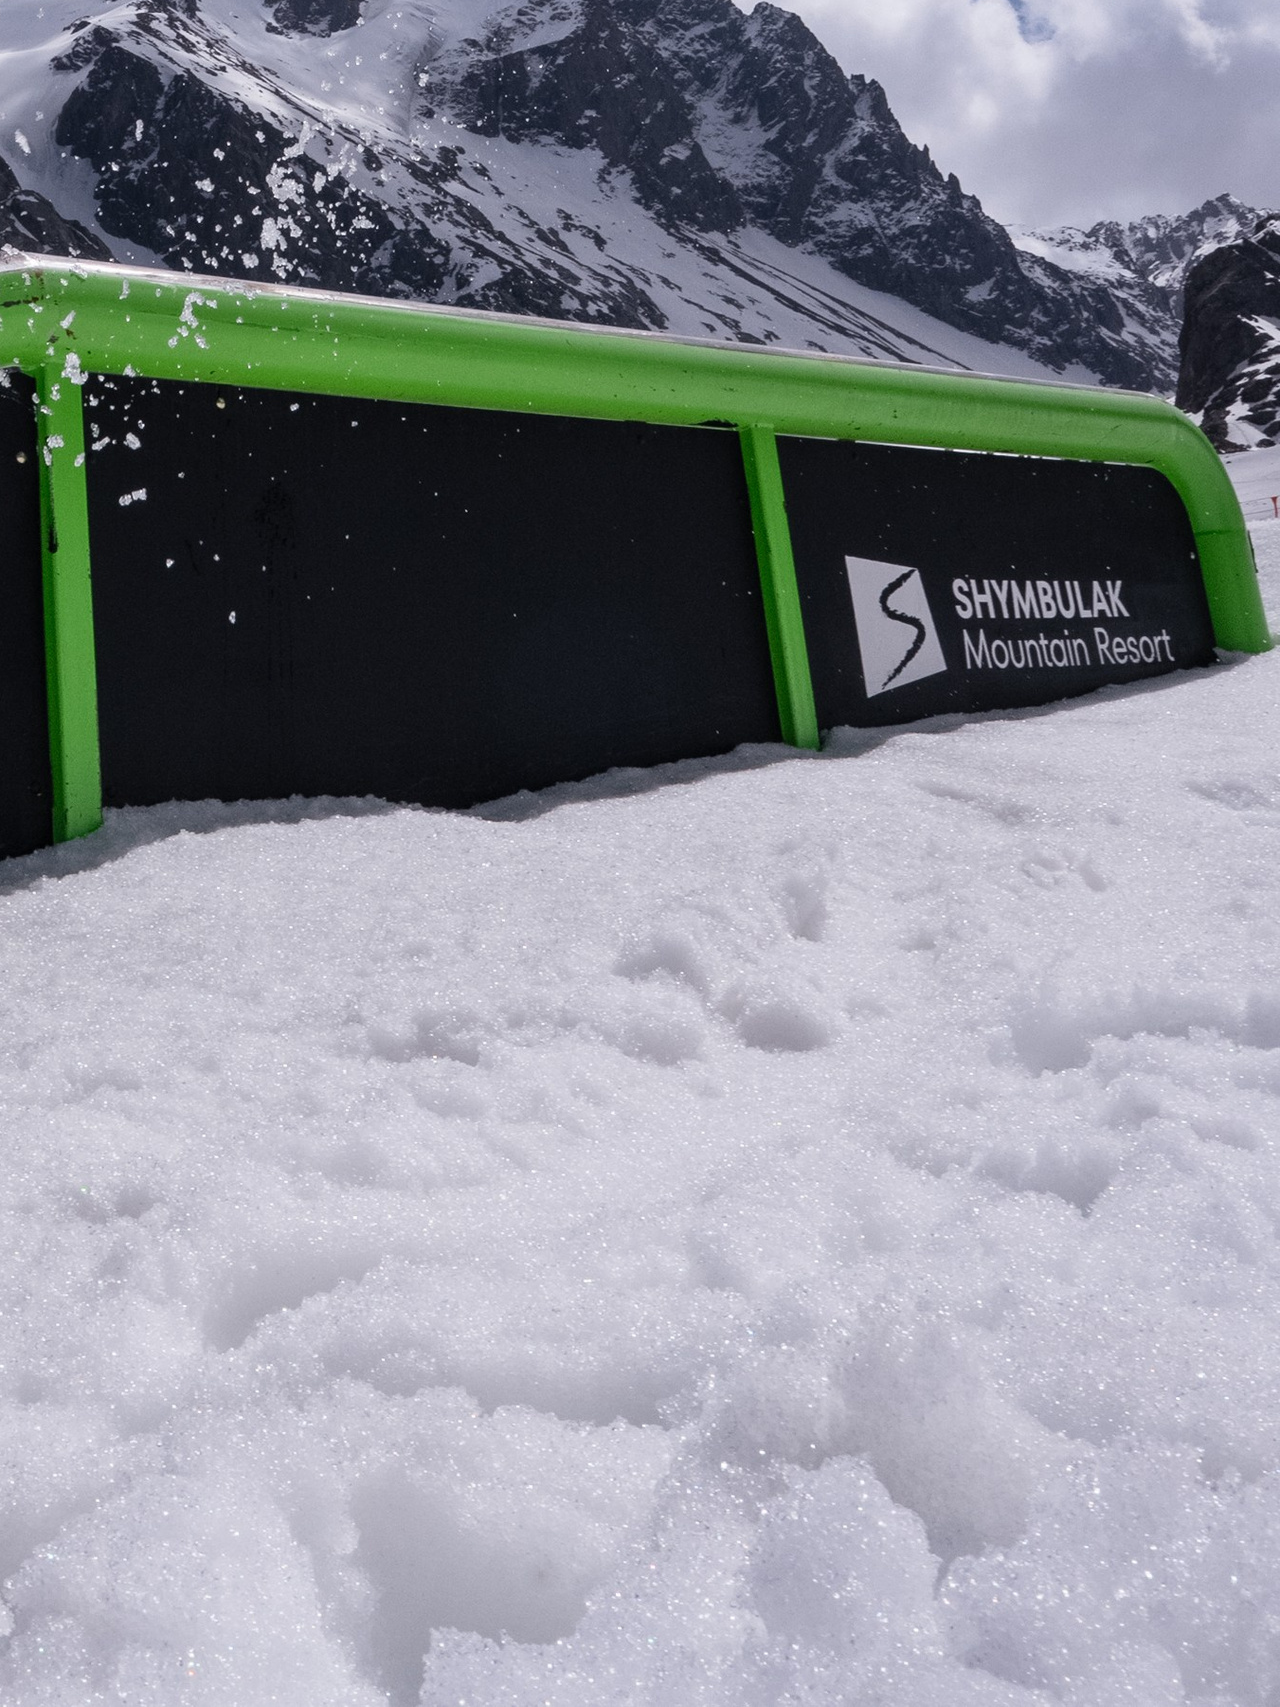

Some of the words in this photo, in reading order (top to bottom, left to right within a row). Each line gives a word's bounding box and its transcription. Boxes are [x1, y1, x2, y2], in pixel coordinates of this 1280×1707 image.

[952, 578, 1131, 620] SHYMBULAK
[962, 627, 1090, 670] Mountain
[1095, 627, 1176, 667] Resort
